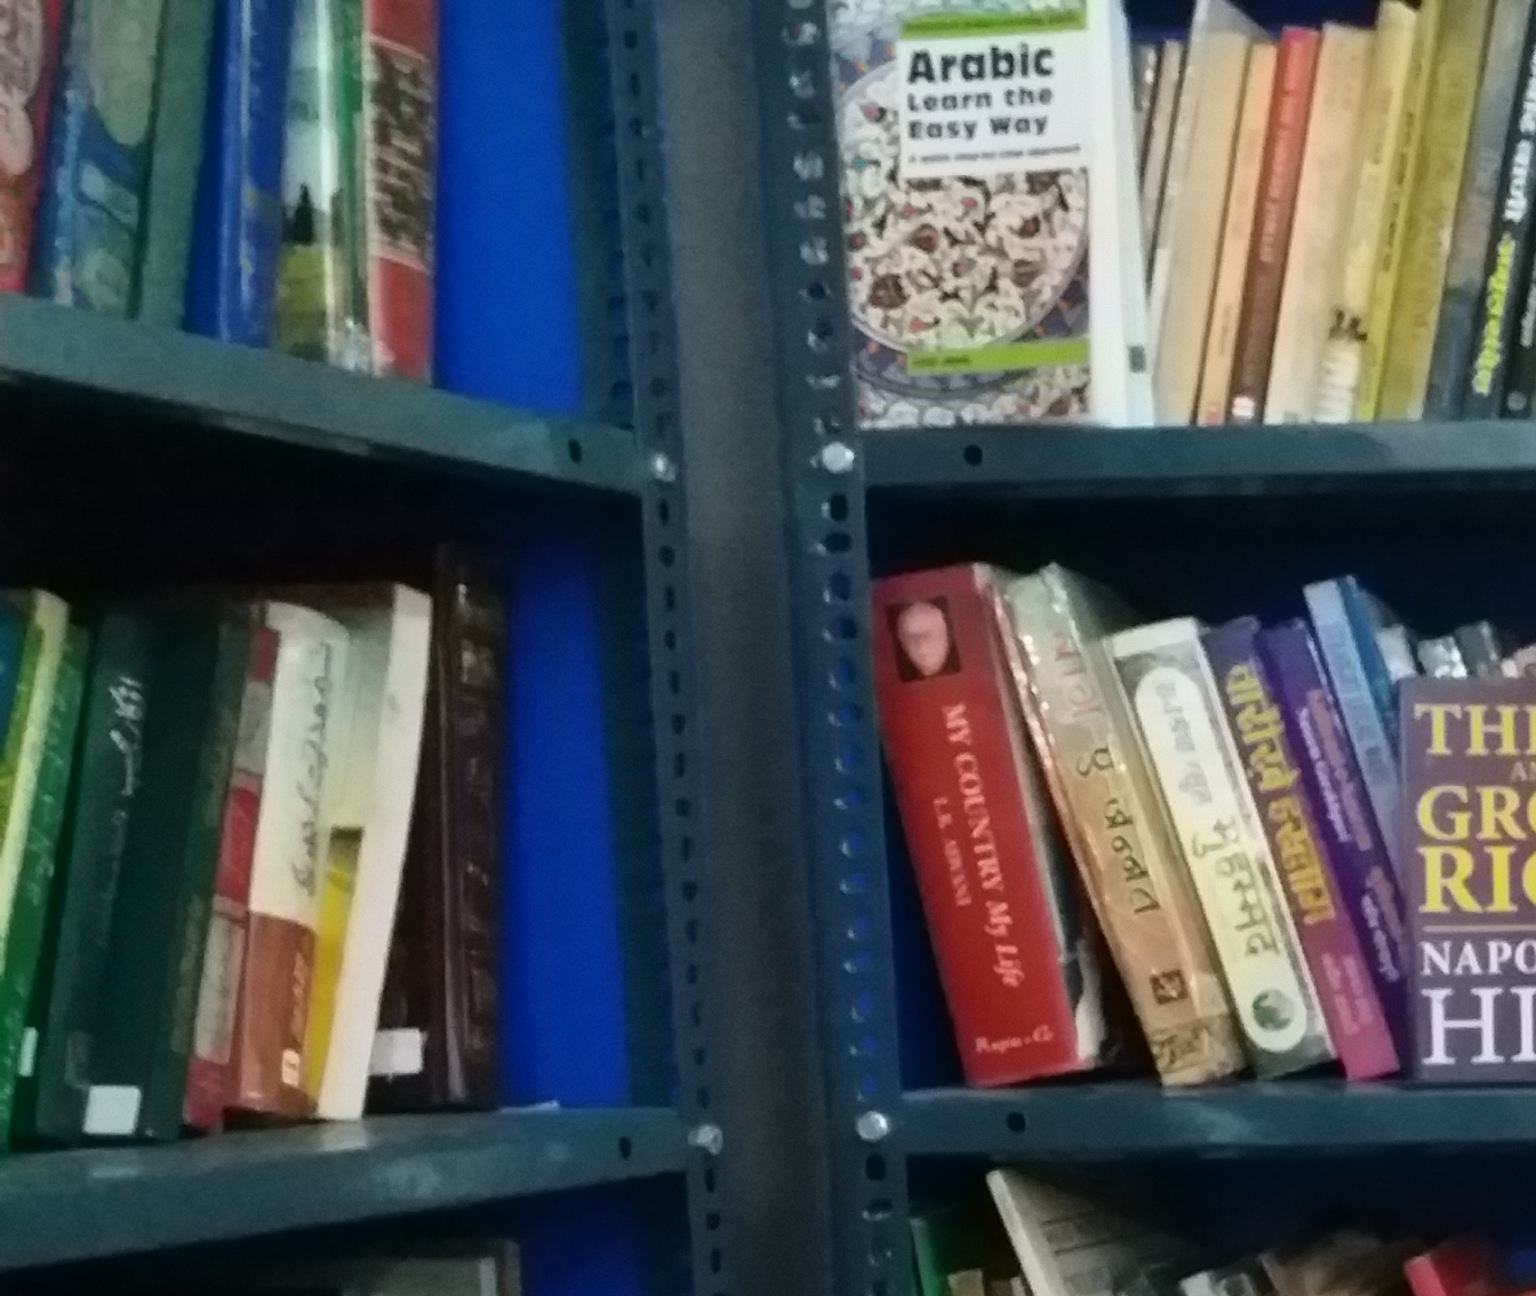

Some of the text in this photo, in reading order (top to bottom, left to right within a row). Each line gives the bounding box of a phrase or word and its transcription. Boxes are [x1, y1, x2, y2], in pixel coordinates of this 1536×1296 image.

[907, 43, 1054, 84] Arabic
[907, 86, 1053, 112] Learn the
[908, 116, 1047, 140] Easy Way
[942, 702, 1025, 990] MY COUNTRY My Life
[1189, 817, 1281, 961] मुहम्मद
